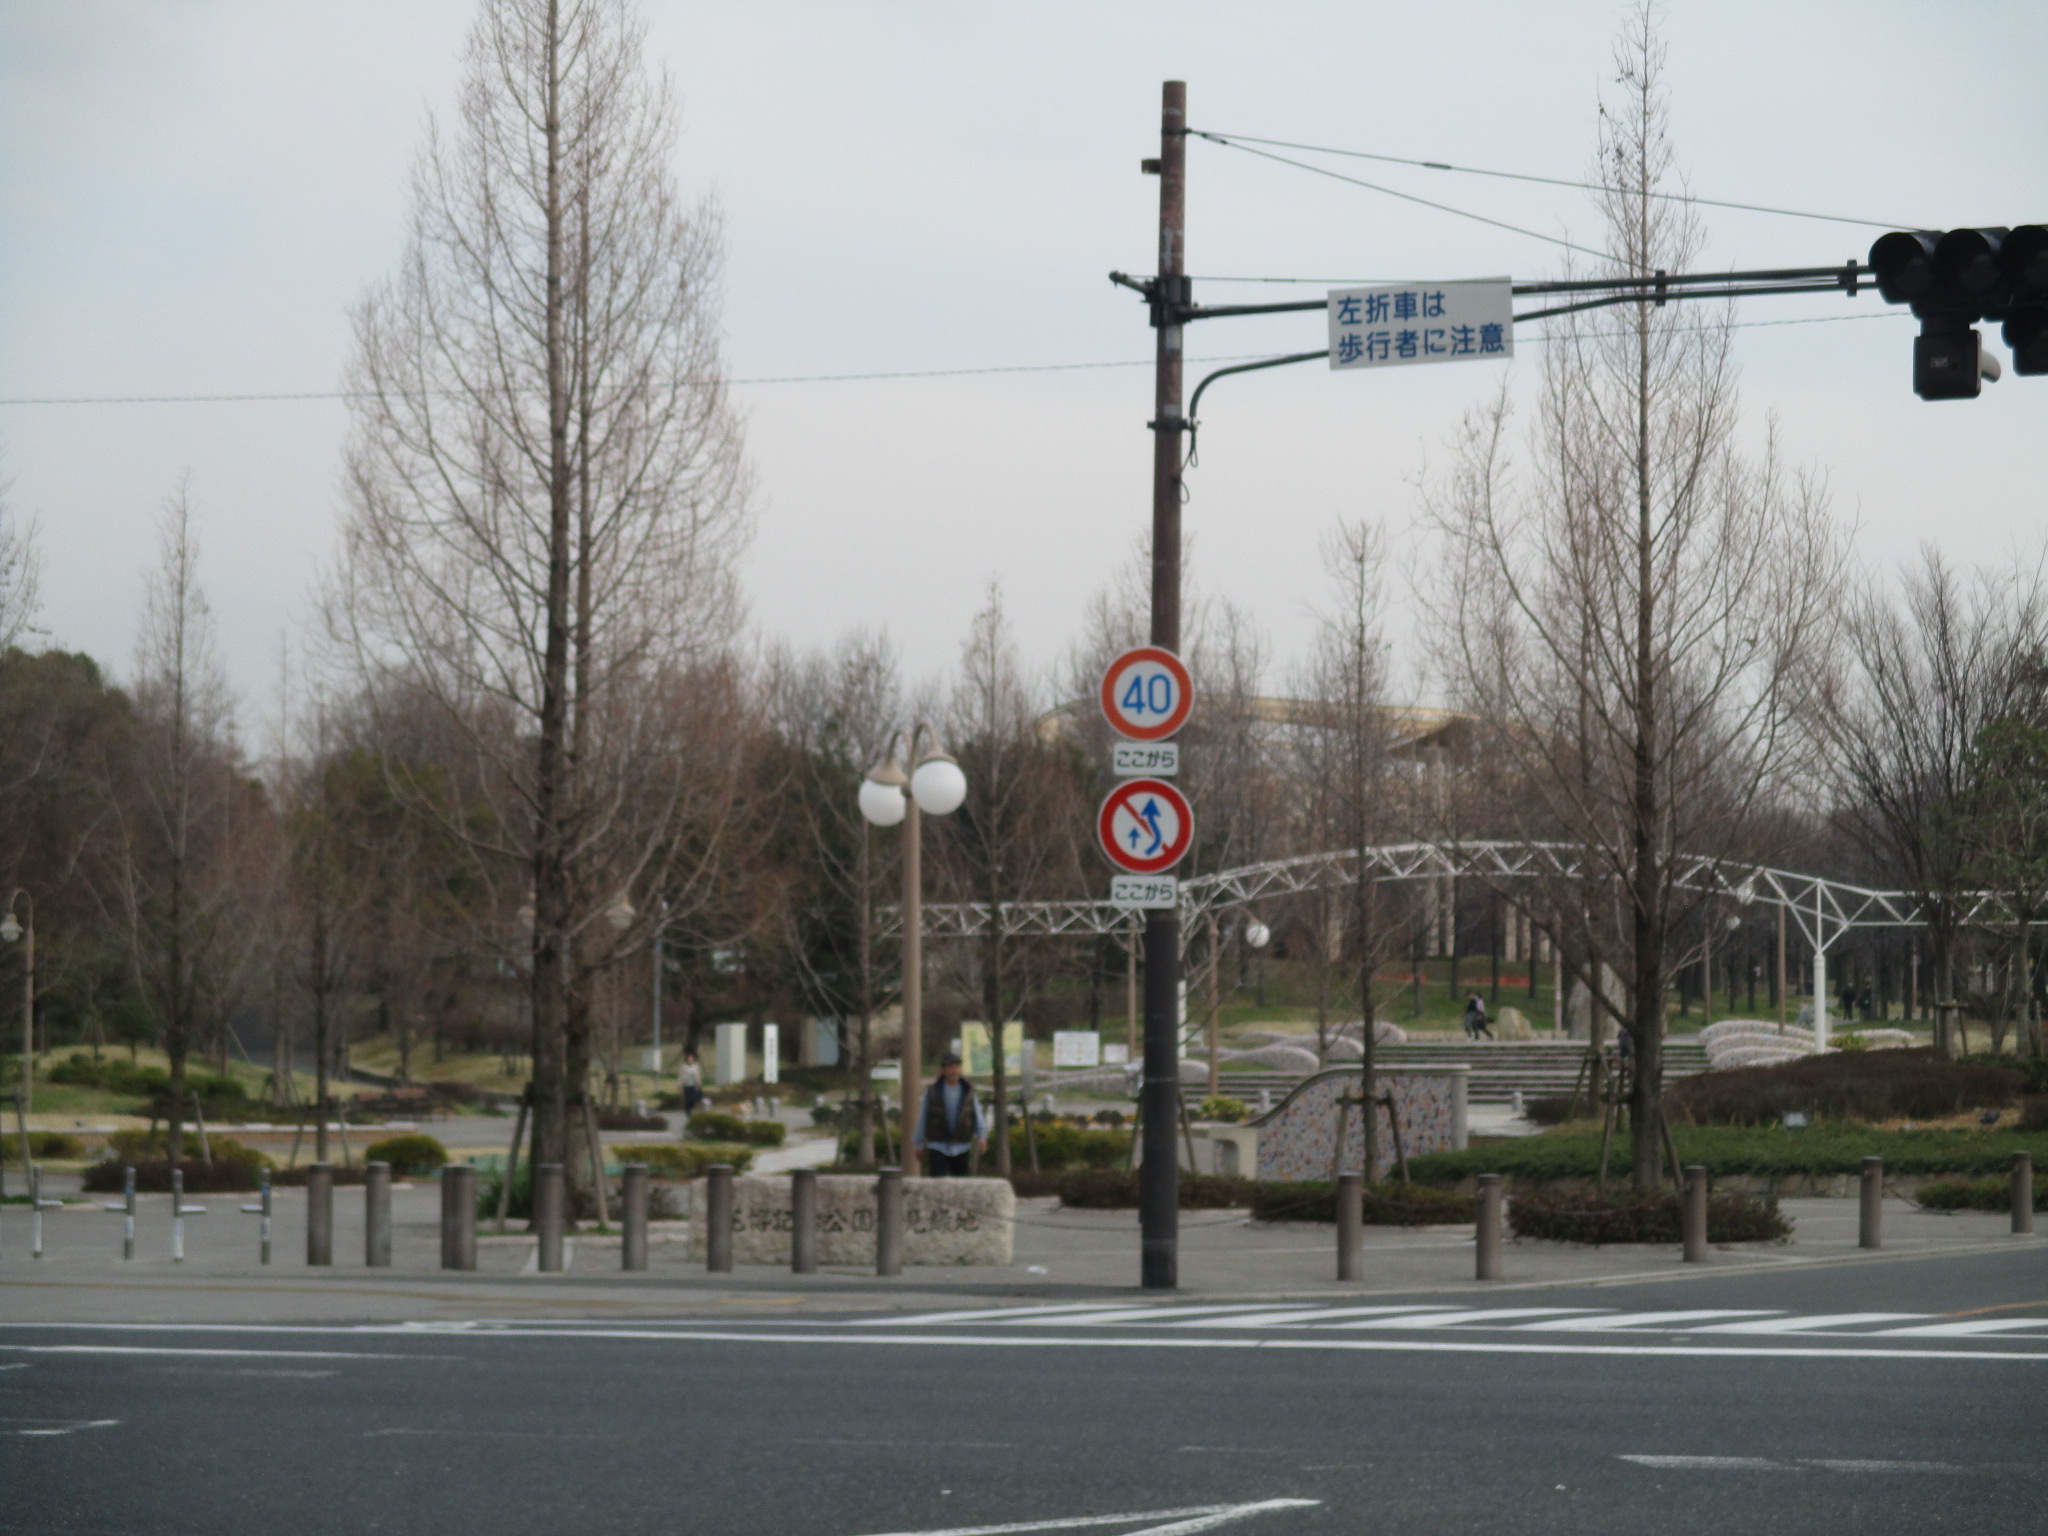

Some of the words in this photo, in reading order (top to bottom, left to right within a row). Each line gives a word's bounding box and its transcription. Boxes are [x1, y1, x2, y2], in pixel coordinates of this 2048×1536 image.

[1337, 290, 1446, 326] 左折車は
[1339, 322, 1505, 364] 歩行者に注意
[1123, 674, 1171, 714] 40
[1117, 751, 1174, 768] ここから
[1115, 884, 1173, 901] ここから
